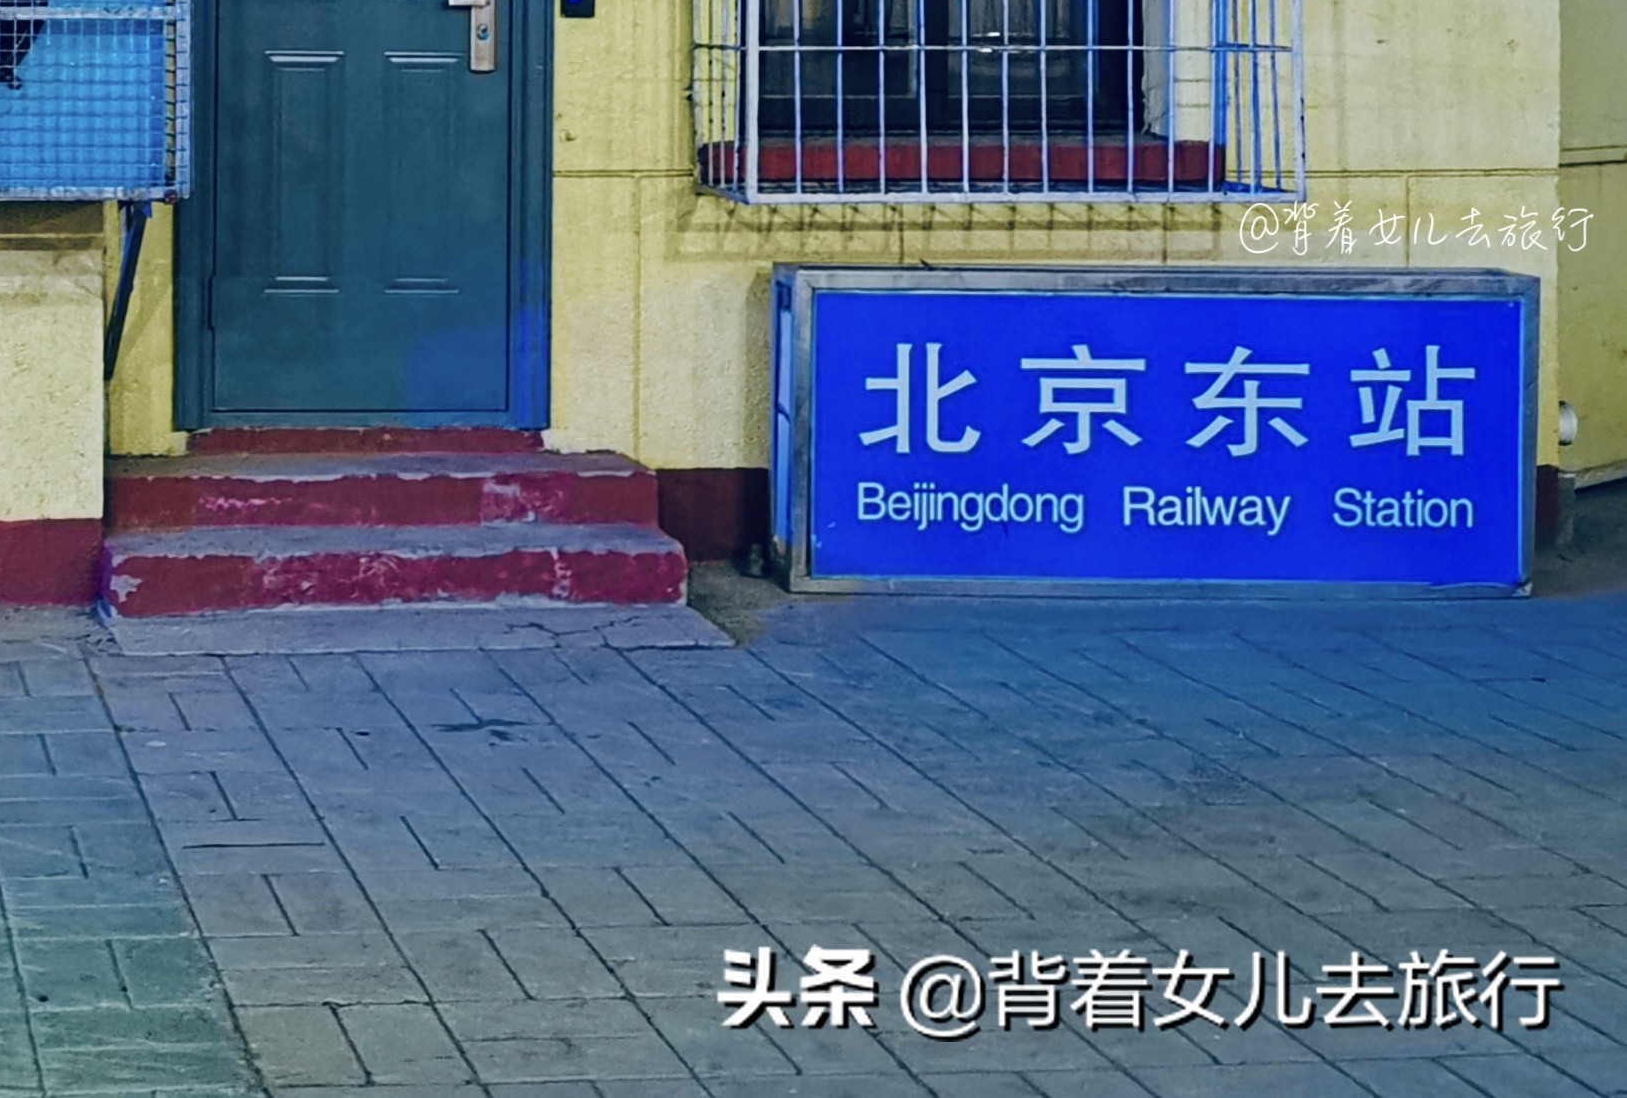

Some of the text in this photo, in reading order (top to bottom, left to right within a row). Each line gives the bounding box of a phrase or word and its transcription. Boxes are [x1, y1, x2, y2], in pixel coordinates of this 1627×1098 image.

[858, 342, 1476, 457] 北京东站
[857, 481, 1473, 536] Beijingdong Railway Station
